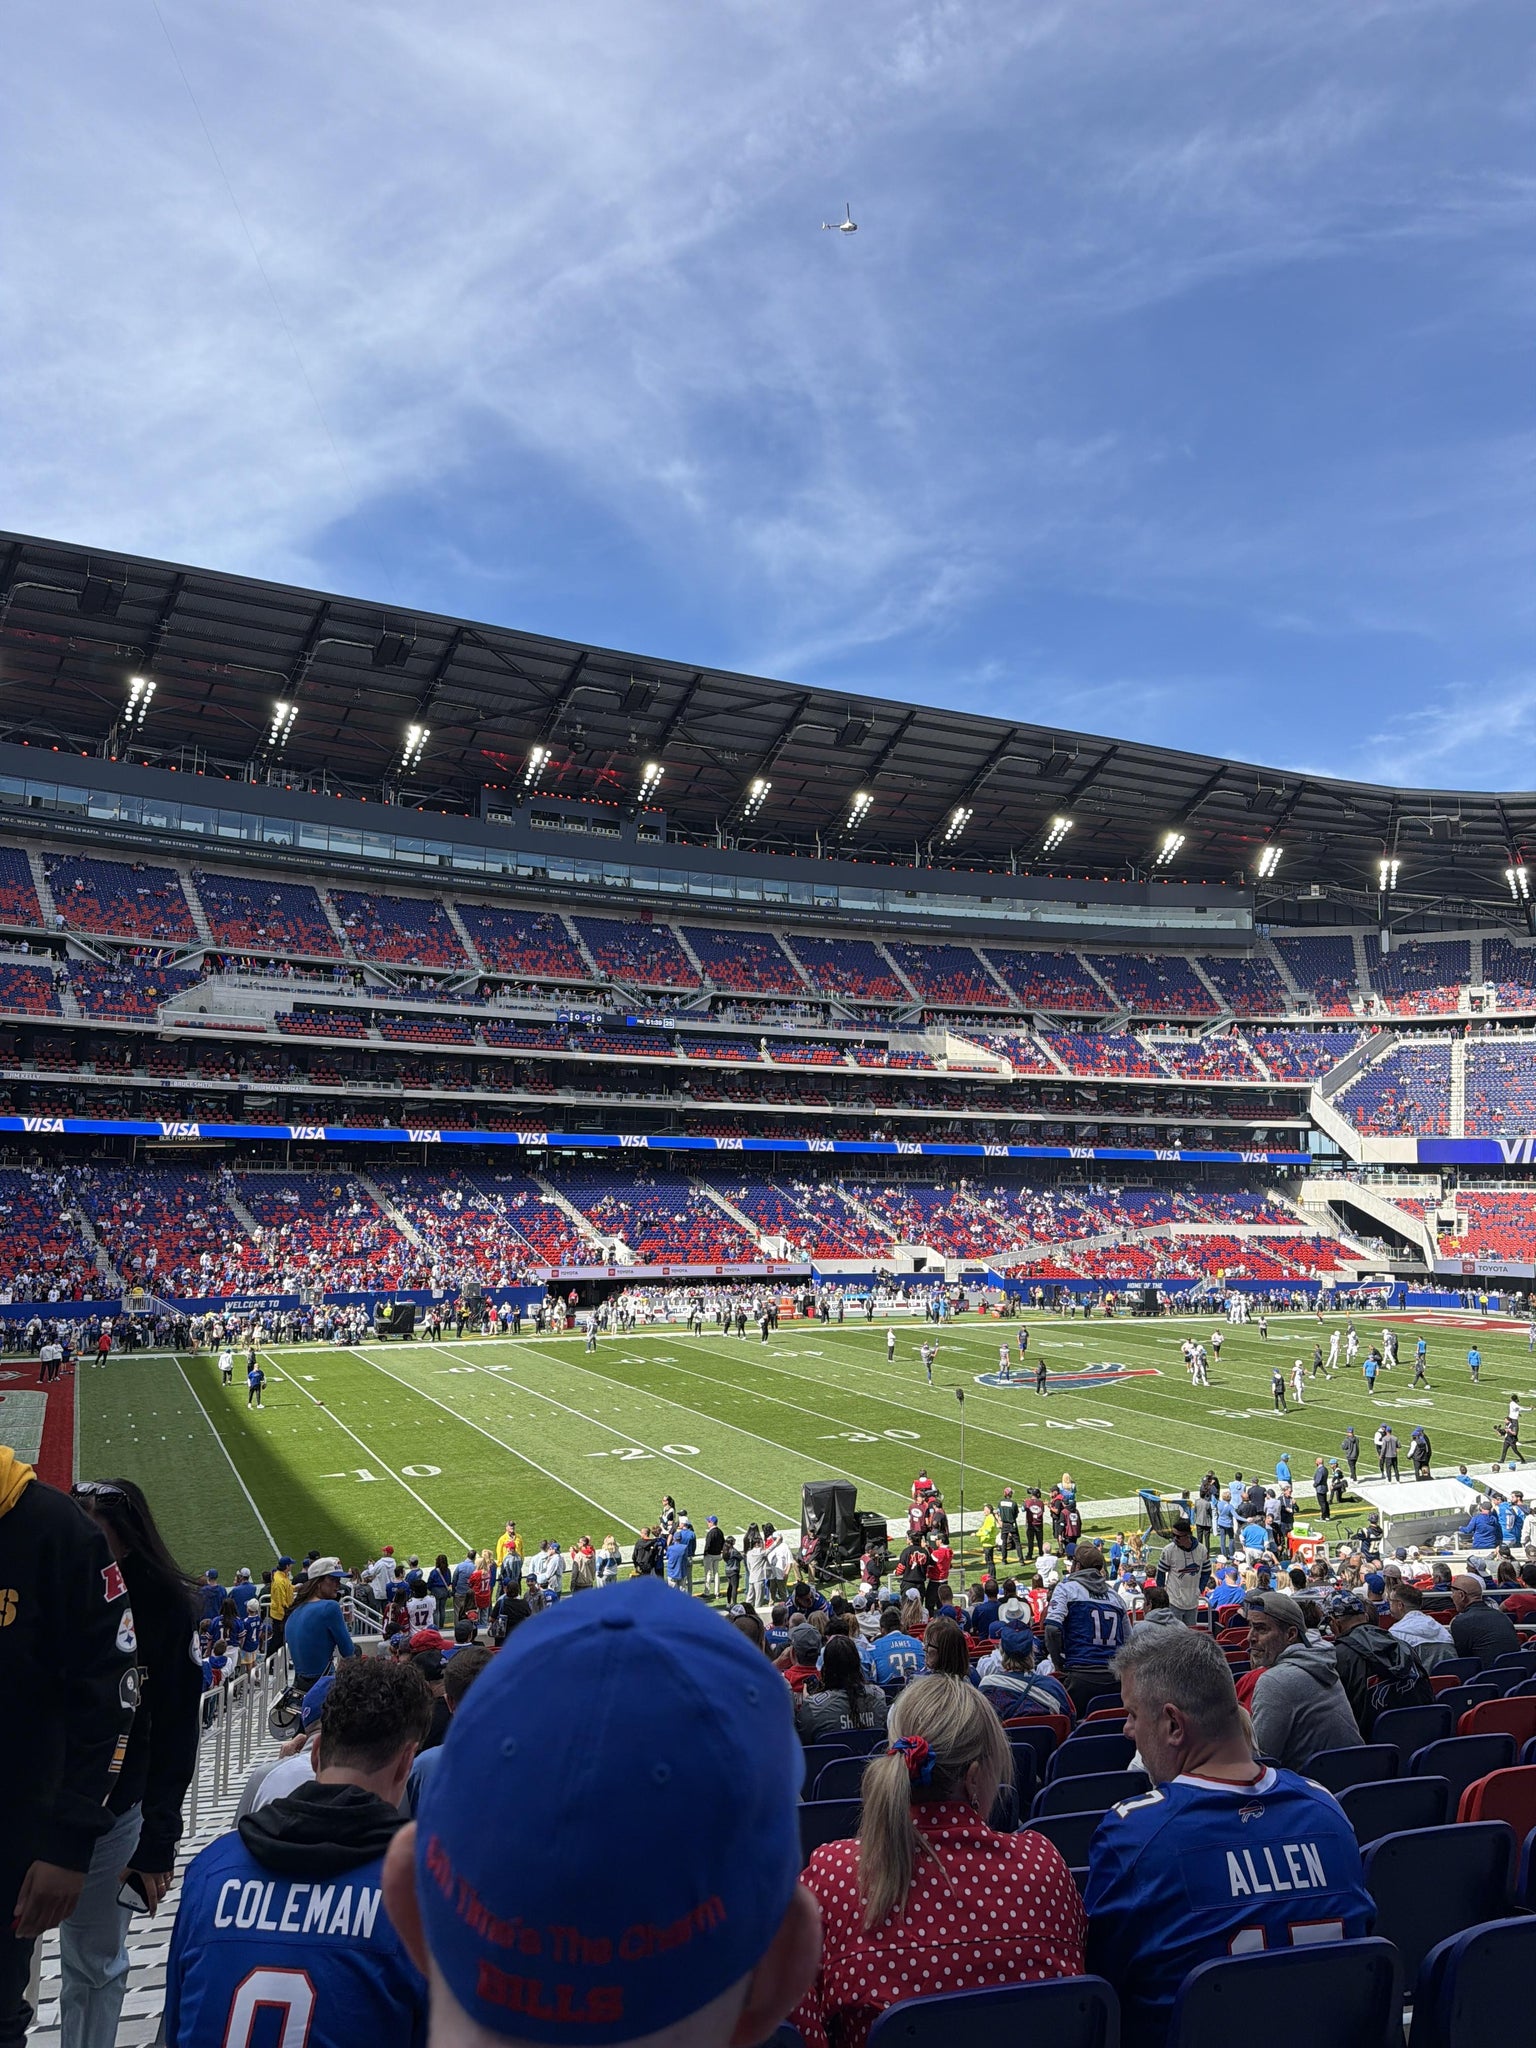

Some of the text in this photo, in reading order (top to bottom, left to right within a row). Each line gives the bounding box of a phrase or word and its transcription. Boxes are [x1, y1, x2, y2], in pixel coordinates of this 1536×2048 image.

[20, 1072, 40, 1080] KELLY
[20, 1118, 1268, 1163] VISA VISA VISA VISA VISA VISA VISA VISA VISA VISA VISA VISA VISA
[1492, 1139, 1536, 1163] VI
[1478, 1265, 1509, 1273] TOYOTA
[225, 1300, 279, 1309] WELCOME TO
[837, 1429, 921, 1443] 30
[611, 1444, 701, 1461] 20
[351, 1464, 442, 1482] 10
[1298, 1543, 1313, 1558] G
[414, 1610, 429, 1626] 17
[1091, 1609, 1118, 1646] 17
[890, 1640, 911, 1649] JAMES
[840, 1711, 875, 1730] SHKIR
[1225, 1843, 1328, 1897] ALLEN
[214, 1878, 383, 1939] COLEMAN
[547, 1924, 613, 1965] The
[619, 1895, 727, 1960] Charm
[476, 1958, 624, 2024] BILLS
[222, 1966, 317, 2048] 0
